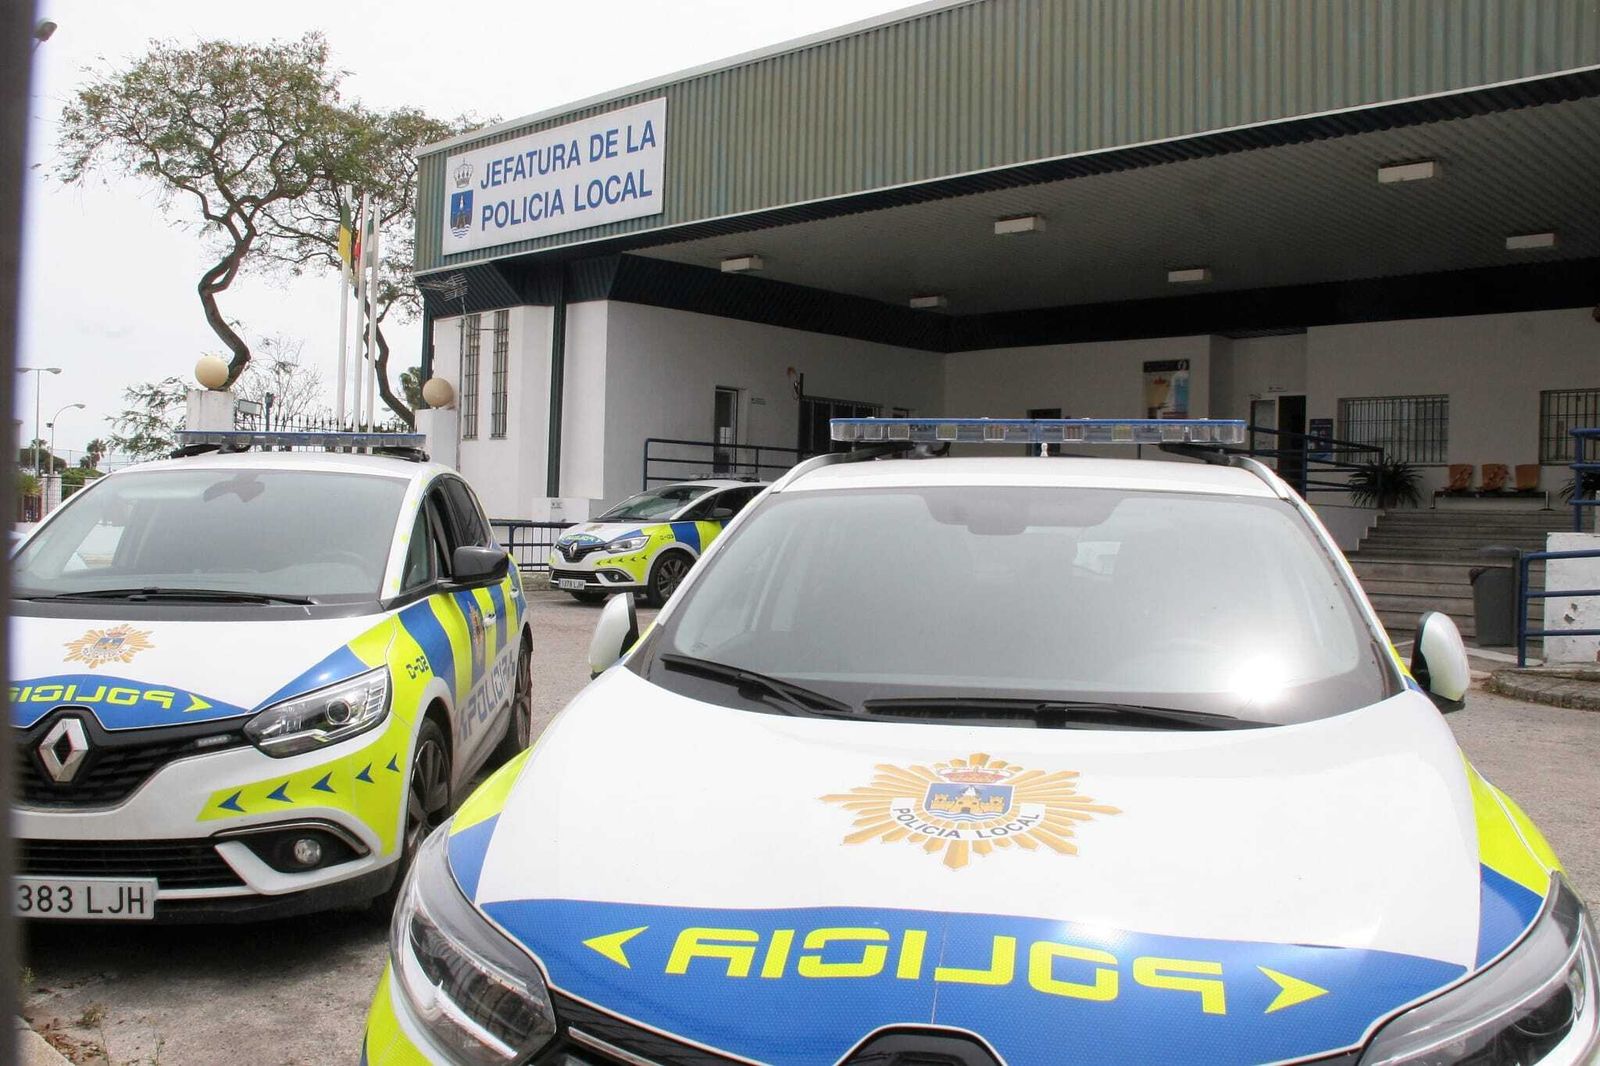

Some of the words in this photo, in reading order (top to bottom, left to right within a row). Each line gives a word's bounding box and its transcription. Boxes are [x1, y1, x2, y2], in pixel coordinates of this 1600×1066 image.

[480, 139, 581, 190] JEFATURA
[589, 128, 619, 164] DE
[626, 119, 656, 154] LA
[481, 188, 564, 232] POLICIA
[574, 168, 653, 212] LOCAL
[892, 807, 961, 839] POLICIA
[975, 812, 1040, 839] LOCAL
[17, 884, 73, 913] 383
[87, 886, 144, 914] LJH
